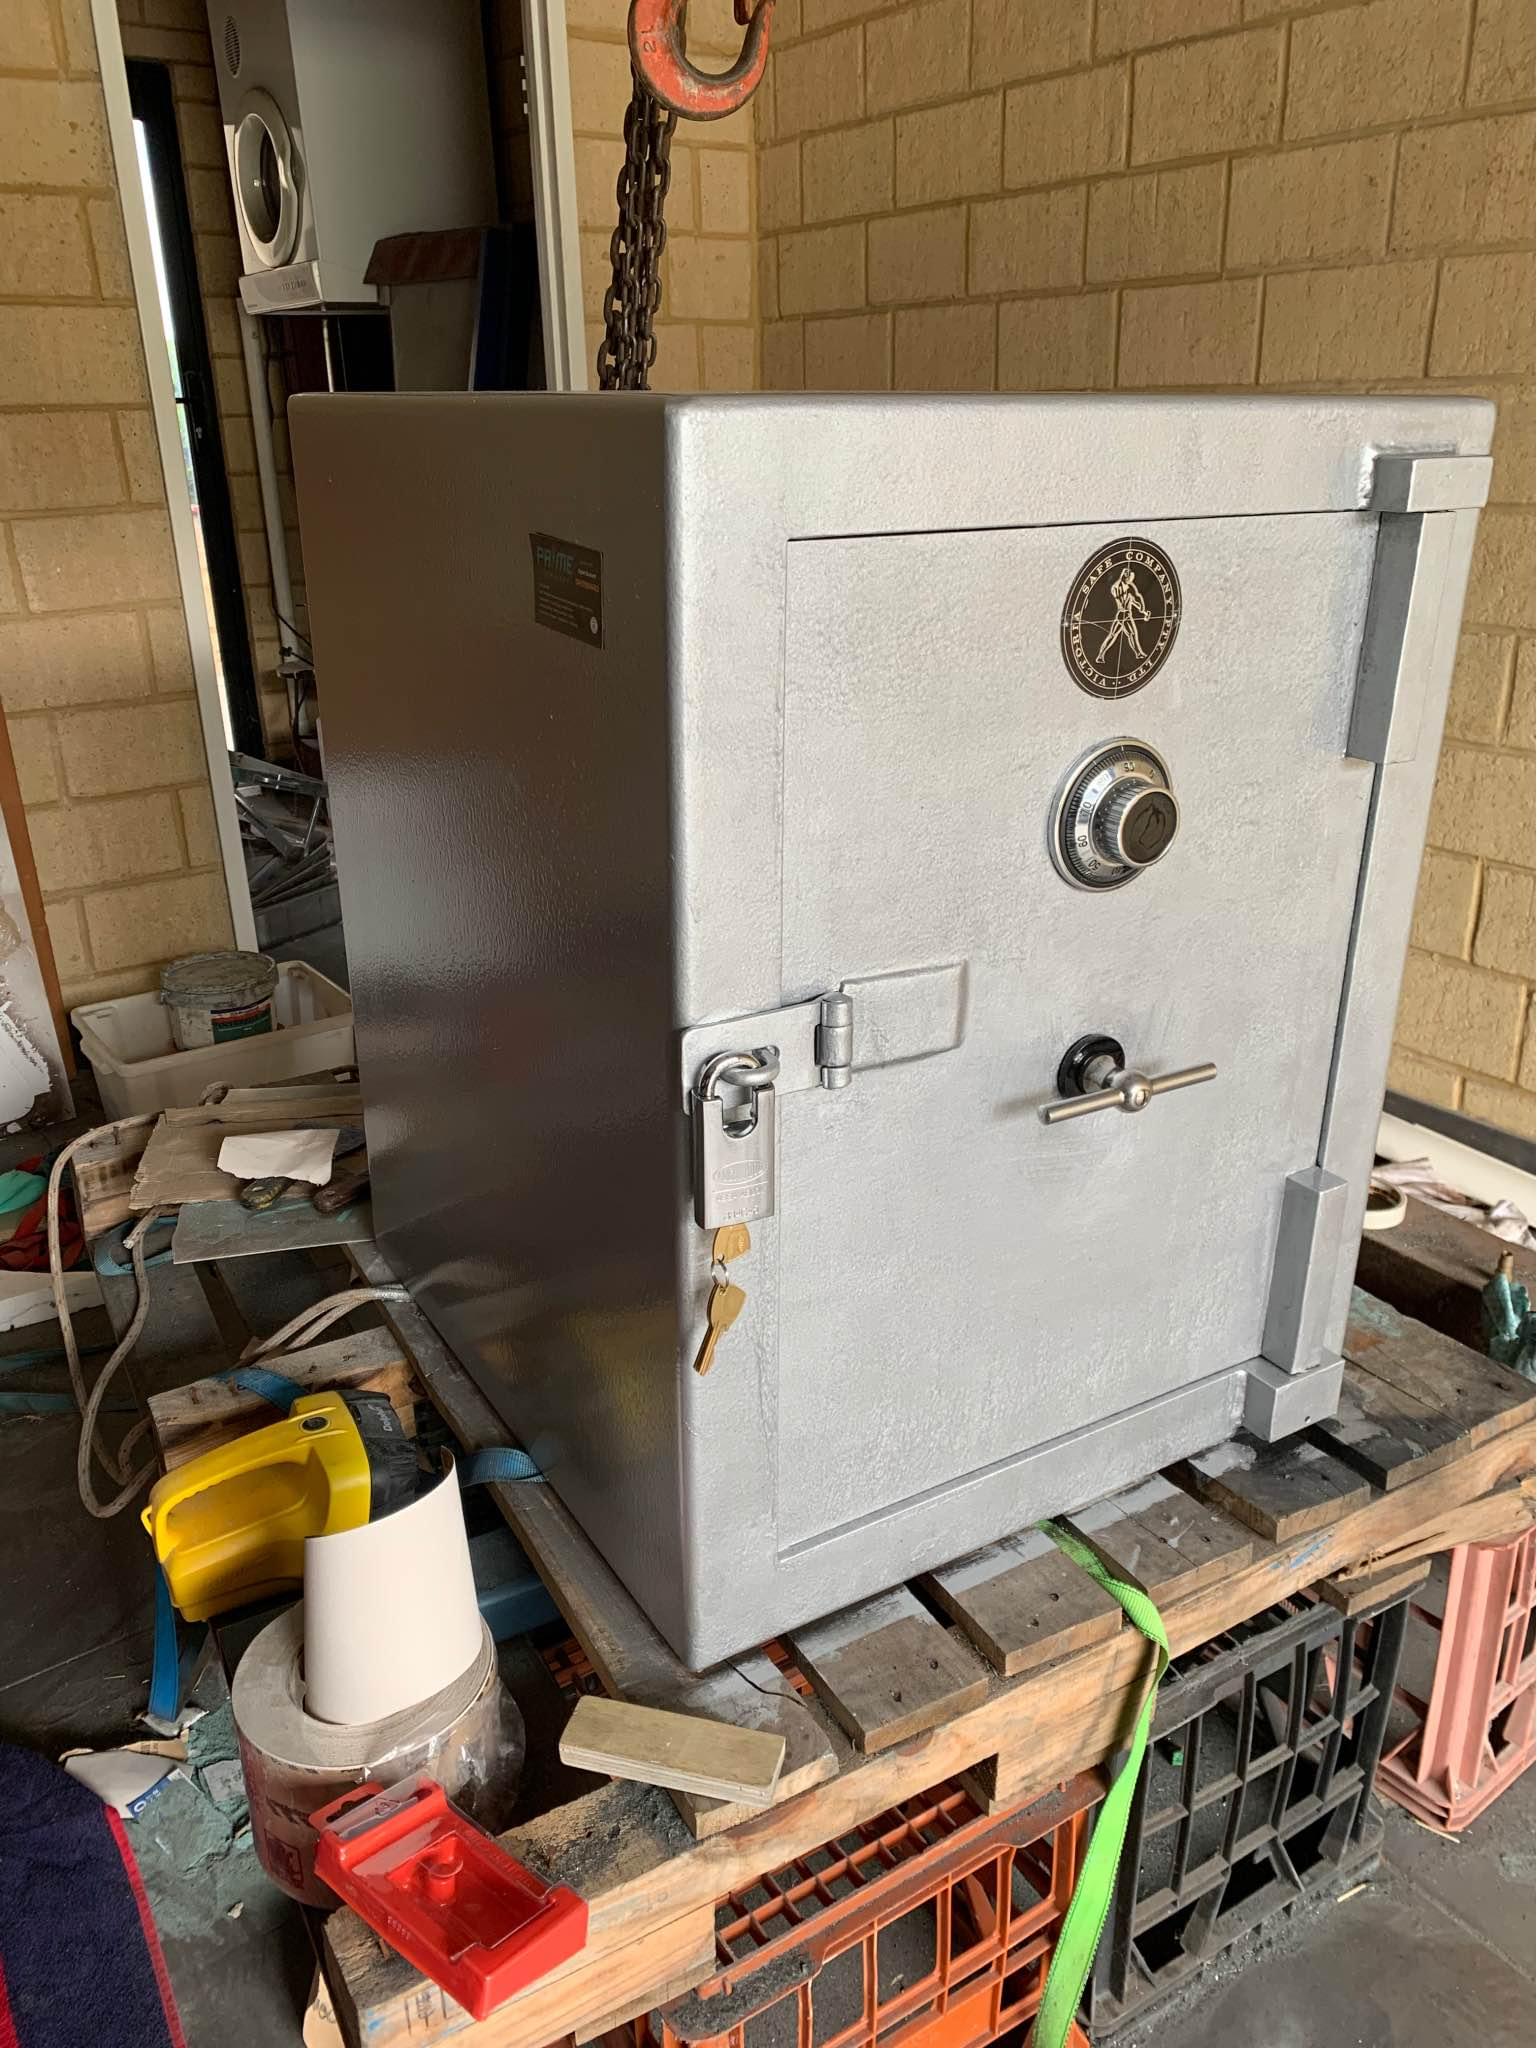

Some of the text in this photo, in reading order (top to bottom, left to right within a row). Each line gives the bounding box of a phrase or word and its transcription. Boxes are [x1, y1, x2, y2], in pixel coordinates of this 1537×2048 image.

[1082, 558, 1113, 595] SAFE
[1125, 551, 1173, 605] COMPANY
[1072, 610, 1107, 687] VICTORIA
[1124, 762, 1136, 772] 90
[1080, 801, 1092, 817] 70
[1077, 835, 1088, 848] 60
[1088, 859, 1101, 871] 50
